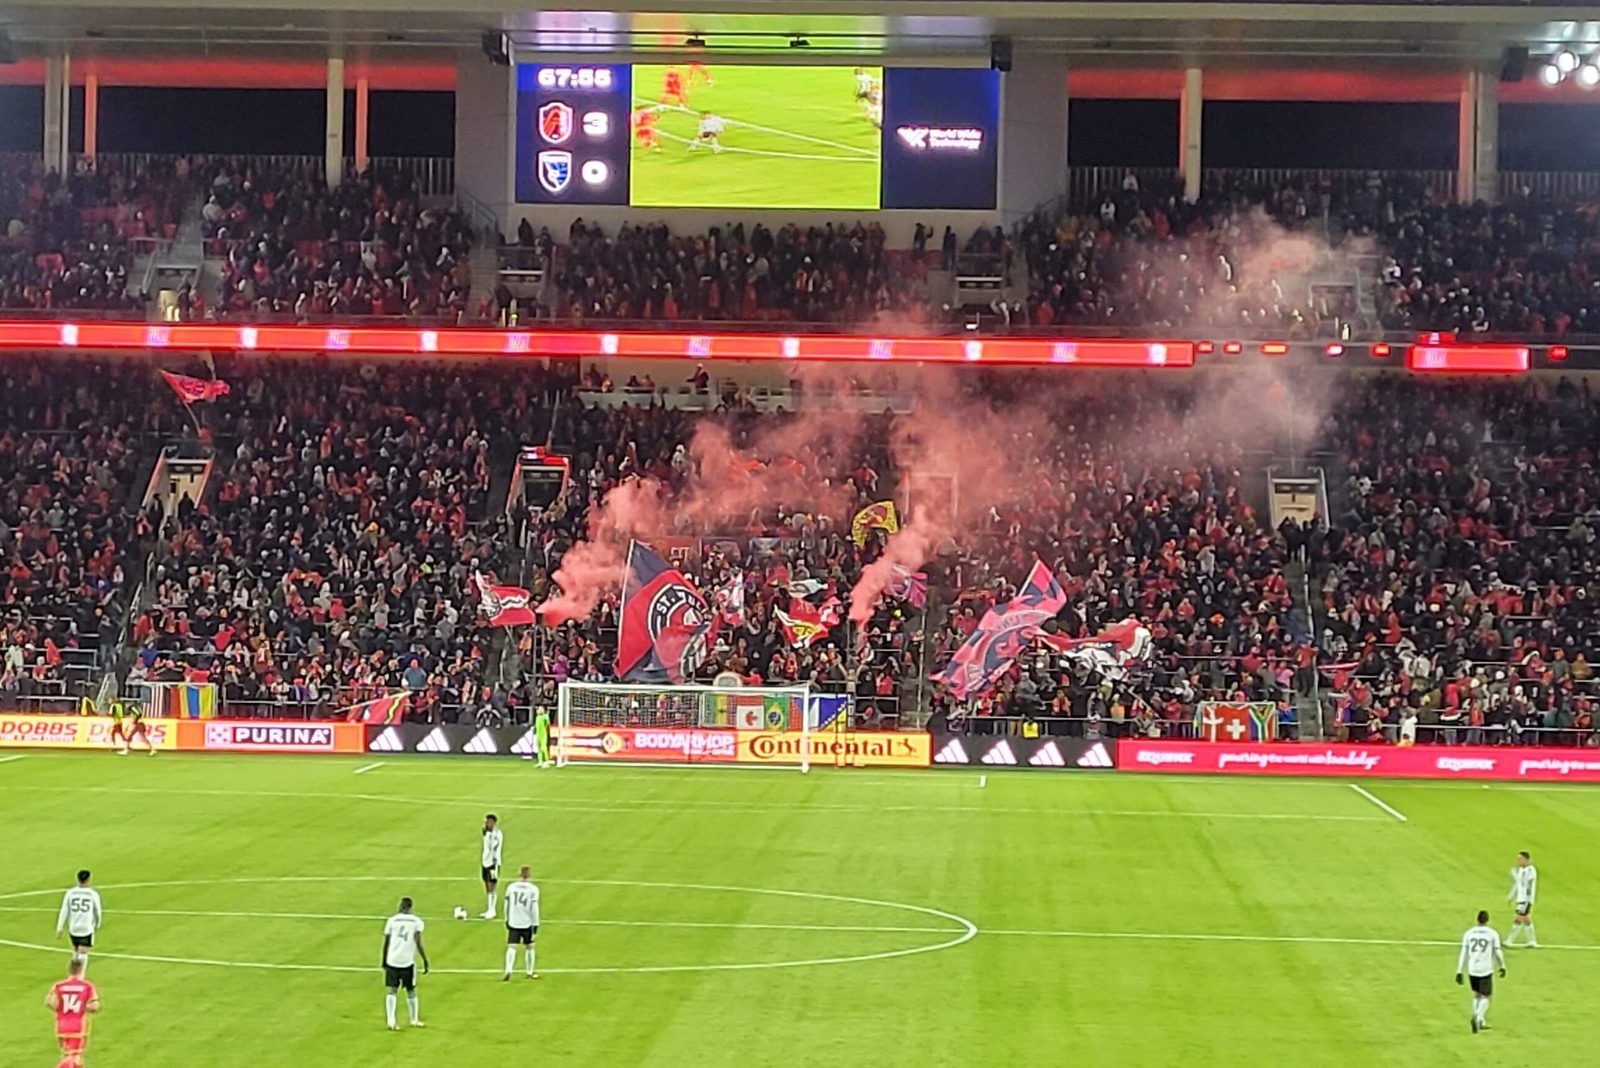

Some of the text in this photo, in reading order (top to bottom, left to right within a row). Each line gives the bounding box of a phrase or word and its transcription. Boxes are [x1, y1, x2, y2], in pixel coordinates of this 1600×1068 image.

[583, 111, 609, 136] 3
[581, 160, 608, 184] 0
[0, 721, 78, 736] DOBBS
[235, 728, 328, 744] PURINA
[750, 735, 892, 759] Continental
[71, 898, 91, 913] 55
[513, 891, 527, 907] 14
[398, 925, 408, 942] 4
[1469, 938, 1489, 953] 29
[61, 994, 82, 1014] 14
